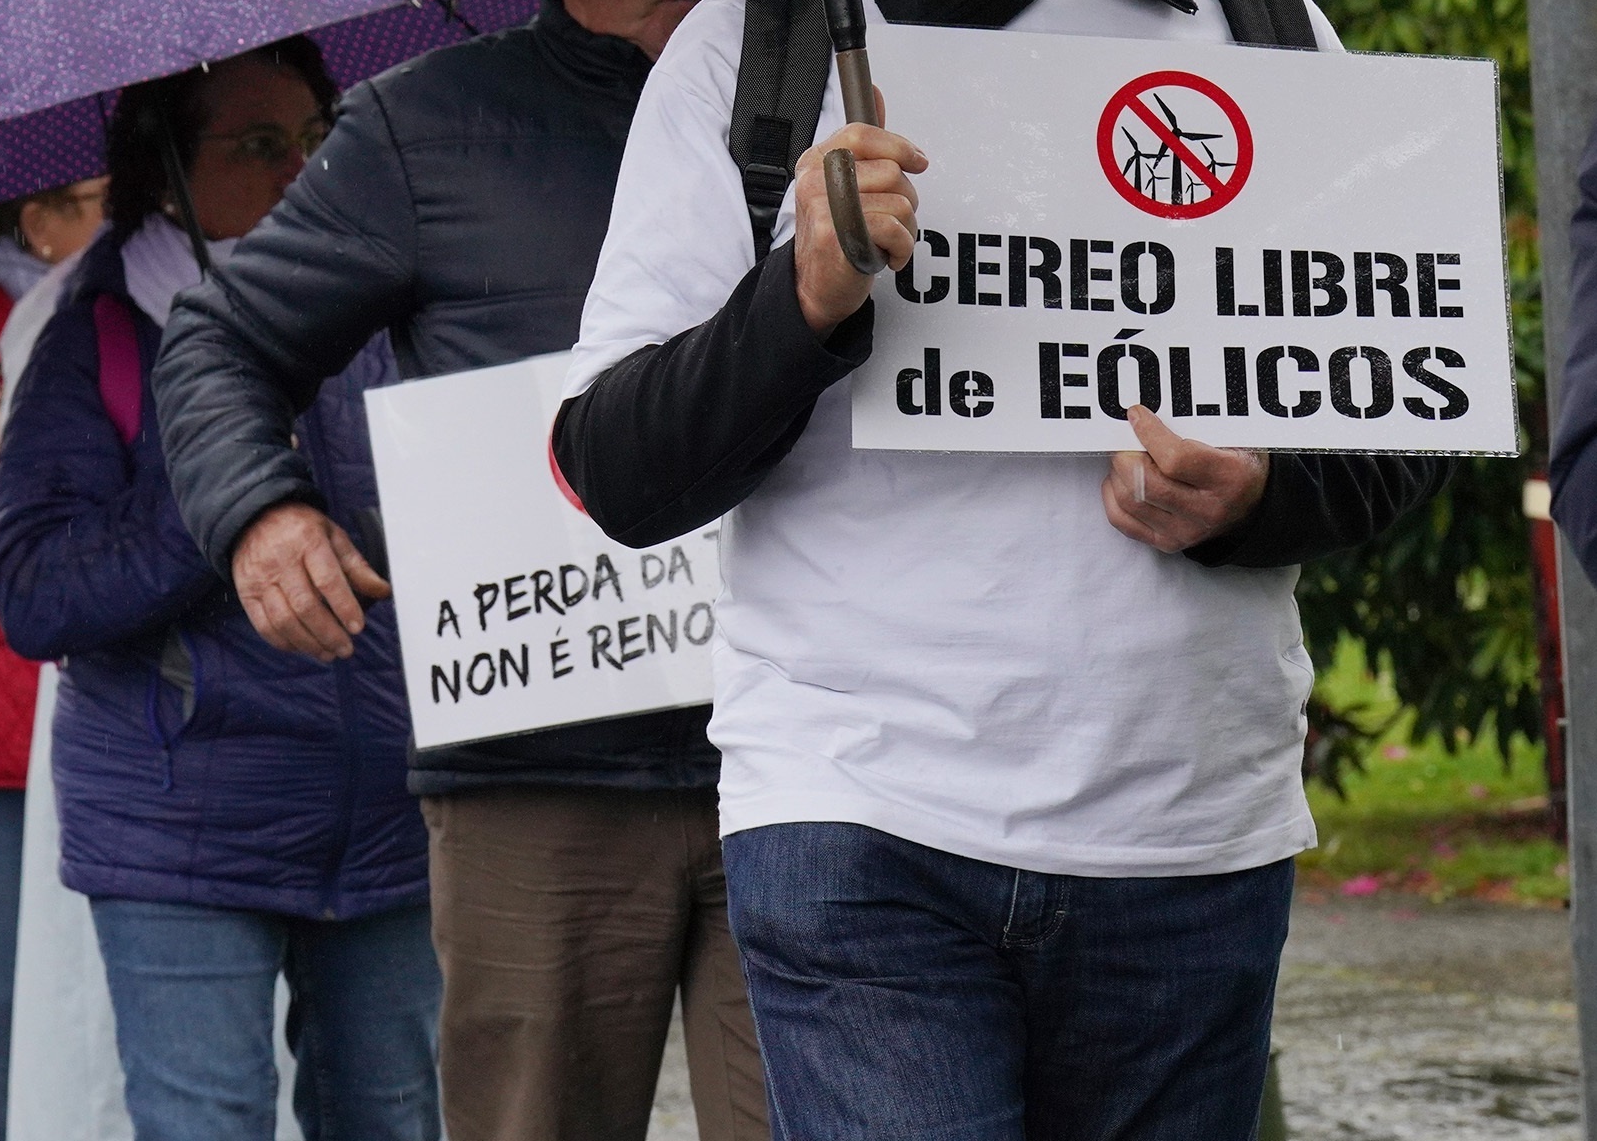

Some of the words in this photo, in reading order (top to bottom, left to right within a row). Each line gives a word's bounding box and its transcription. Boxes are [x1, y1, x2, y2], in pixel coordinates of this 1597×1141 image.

[895, 228, 1177, 315] CEREO
[1215, 246, 1465, 318] LIBRE
[895, 348, 995, 418] de
[1038, 328, 1471, 421] EÓLICOS
[436, 599, 462, 639] A
[473, 552, 625, 632] PERDA
[640, 545, 695, 589] DA
[431, 643, 530, 704] NON
[550, 625, 575, 680] É
[587, 601, 717, 672] RENO
